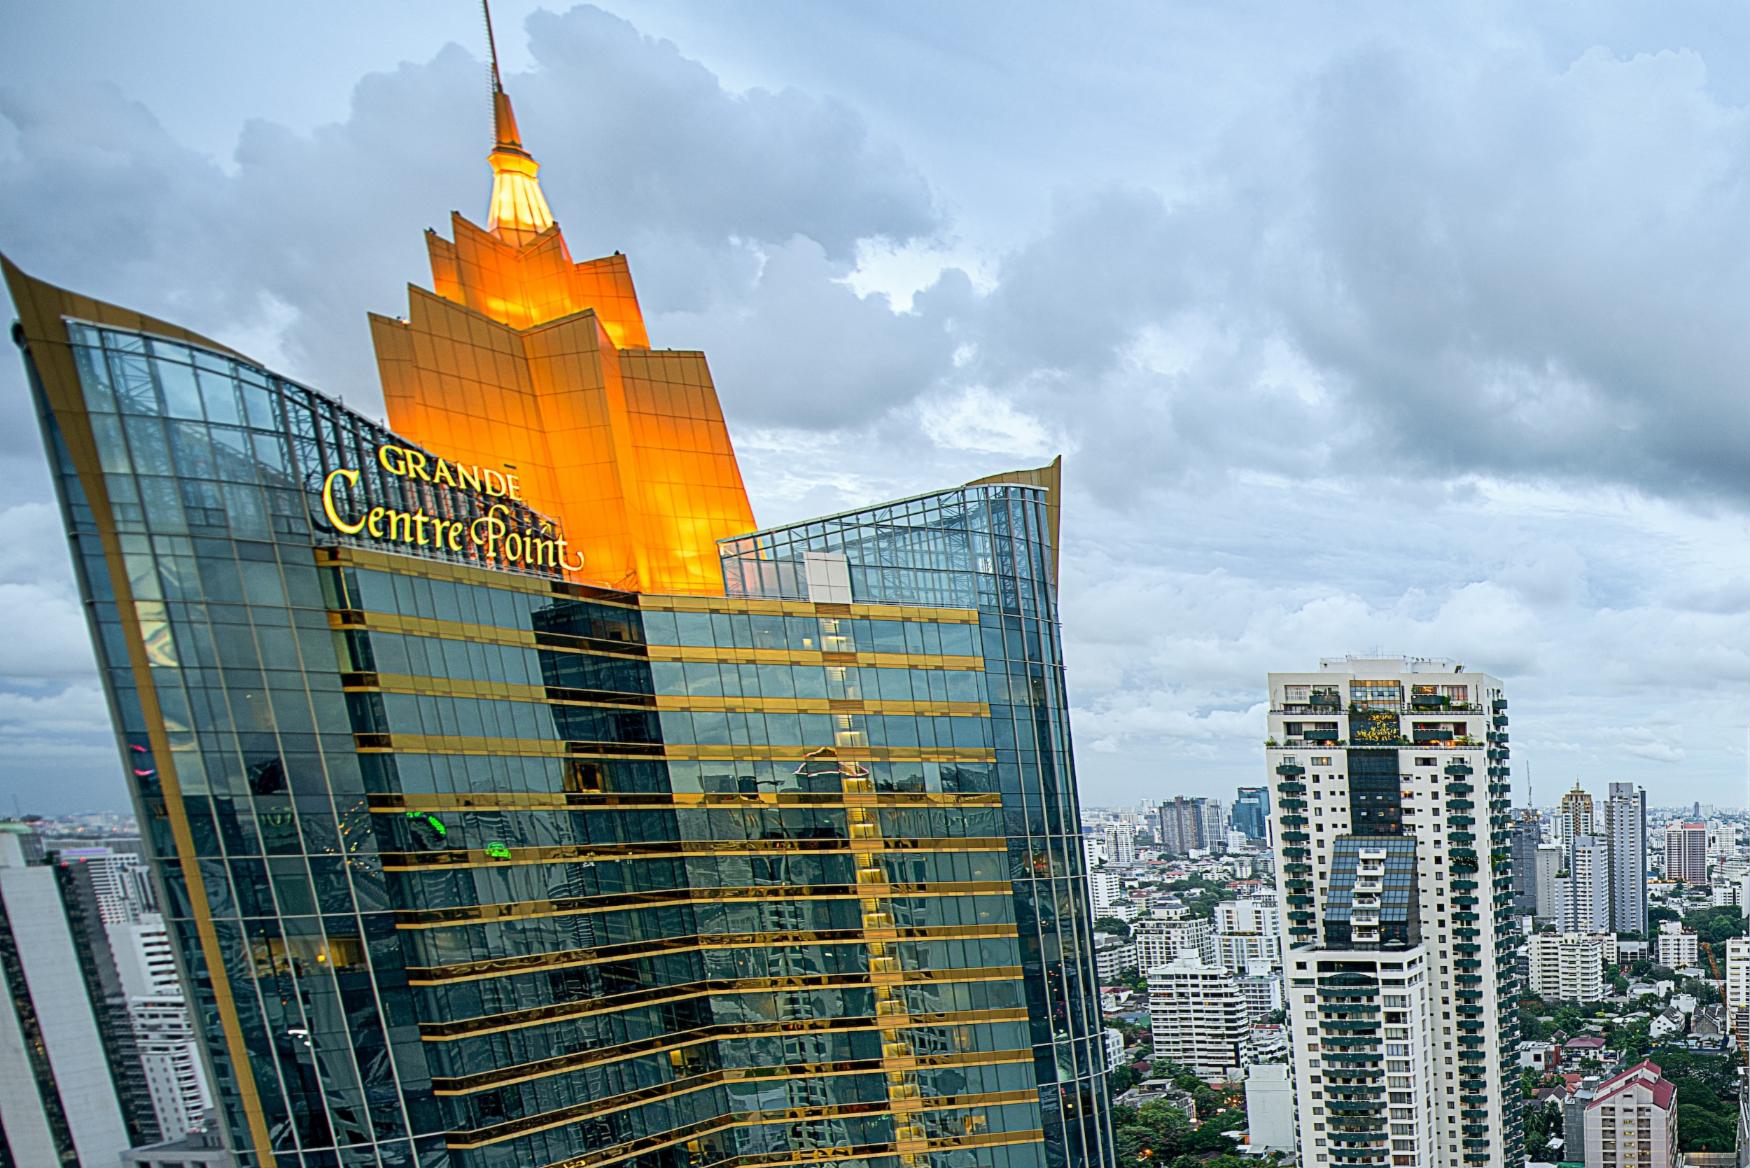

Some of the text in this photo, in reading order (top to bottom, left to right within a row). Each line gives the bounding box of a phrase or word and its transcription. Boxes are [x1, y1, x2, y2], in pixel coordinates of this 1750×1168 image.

[379, 444, 522, 502] GRANDE
[322, 468, 585, 572] Centre Point
